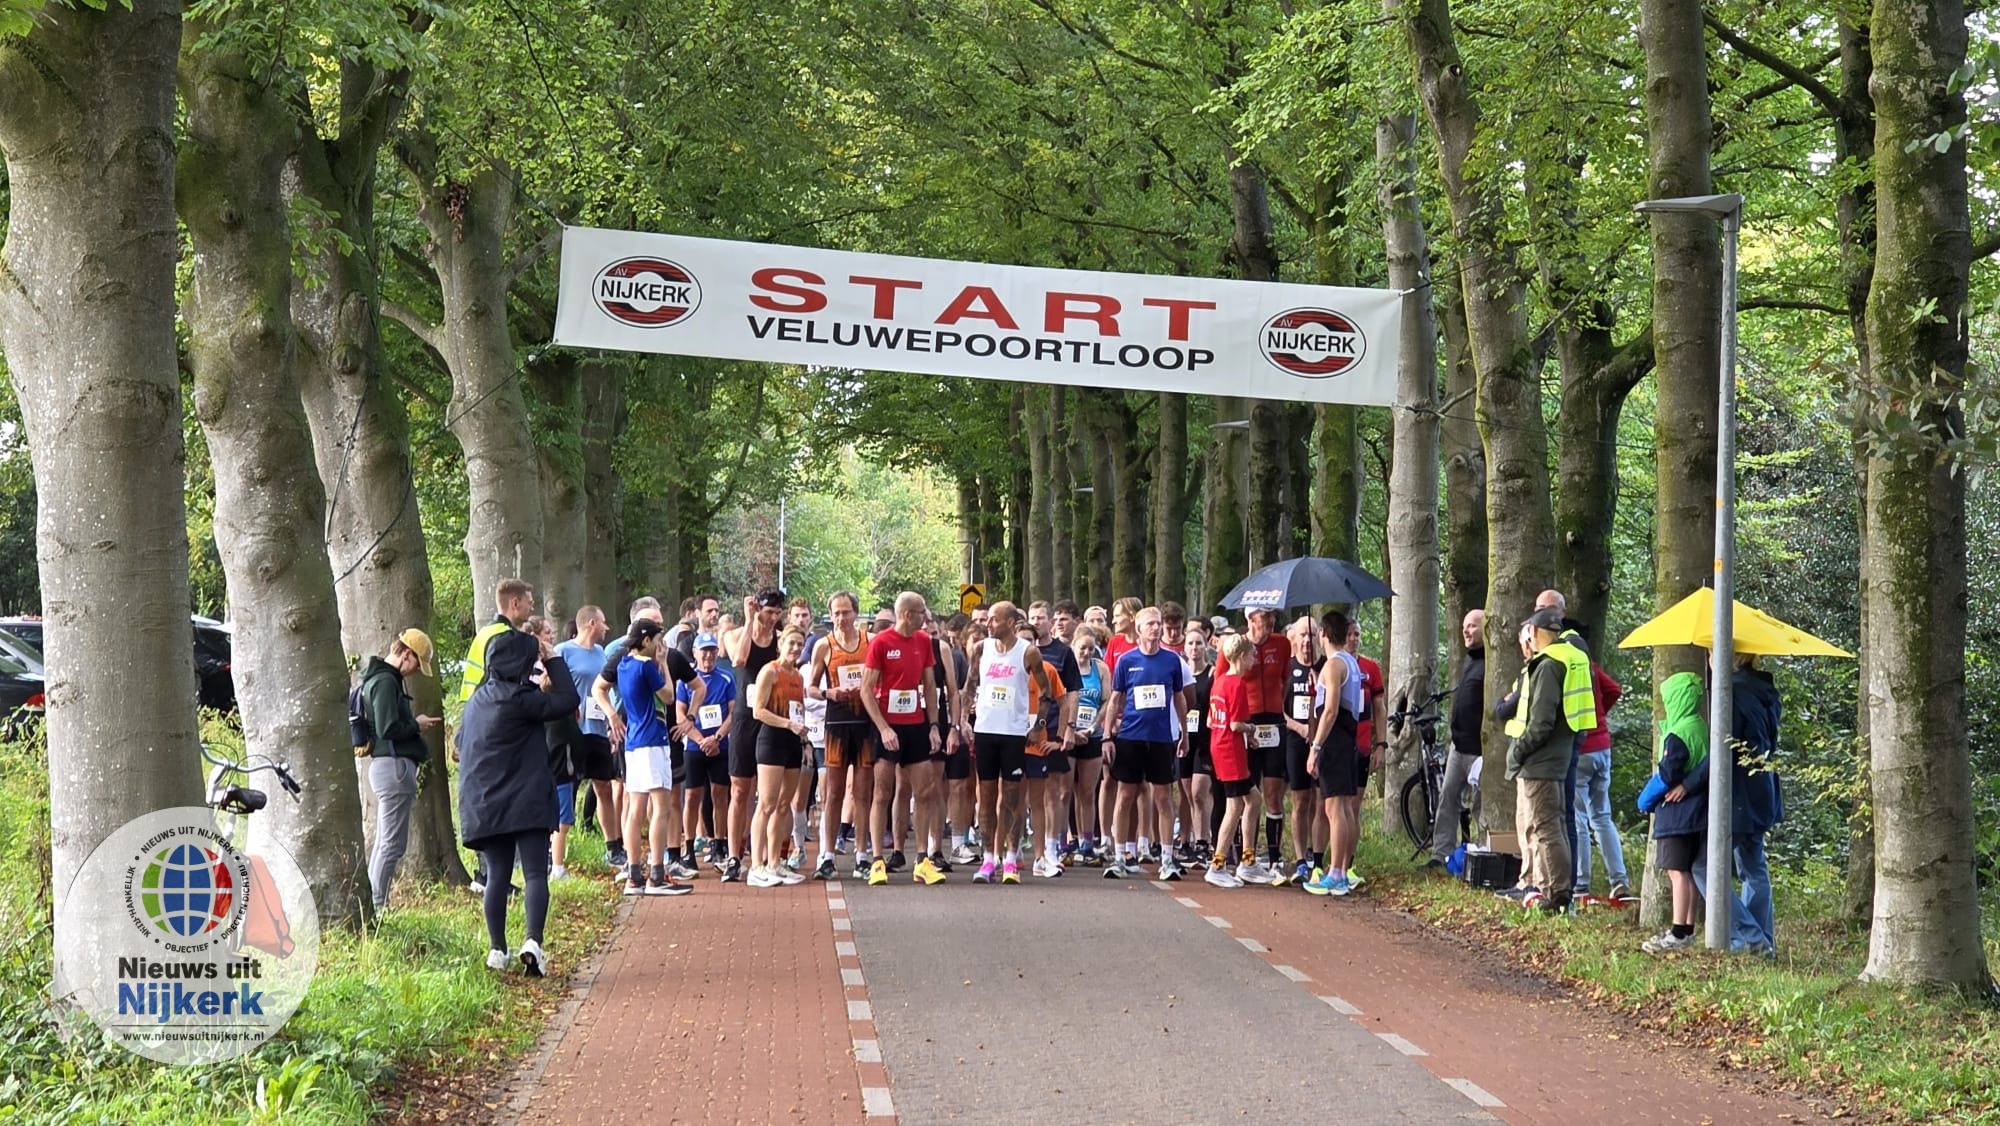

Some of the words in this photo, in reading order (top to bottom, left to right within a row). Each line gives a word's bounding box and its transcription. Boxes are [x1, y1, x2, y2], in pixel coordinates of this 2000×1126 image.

[600, 278, 691, 306] NIJKERK
[748, 266, 1217, 342] START
[746, 314, 1215, 372] VELUWEPOORTLOOP
[1267, 330, 1357, 355] NIJKERK
[897, 697, 911, 705] 499
[991, 692, 1006, 701] 512
[1142, 692, 1157, 700] 515
[704, 711, 718, 719] 497
